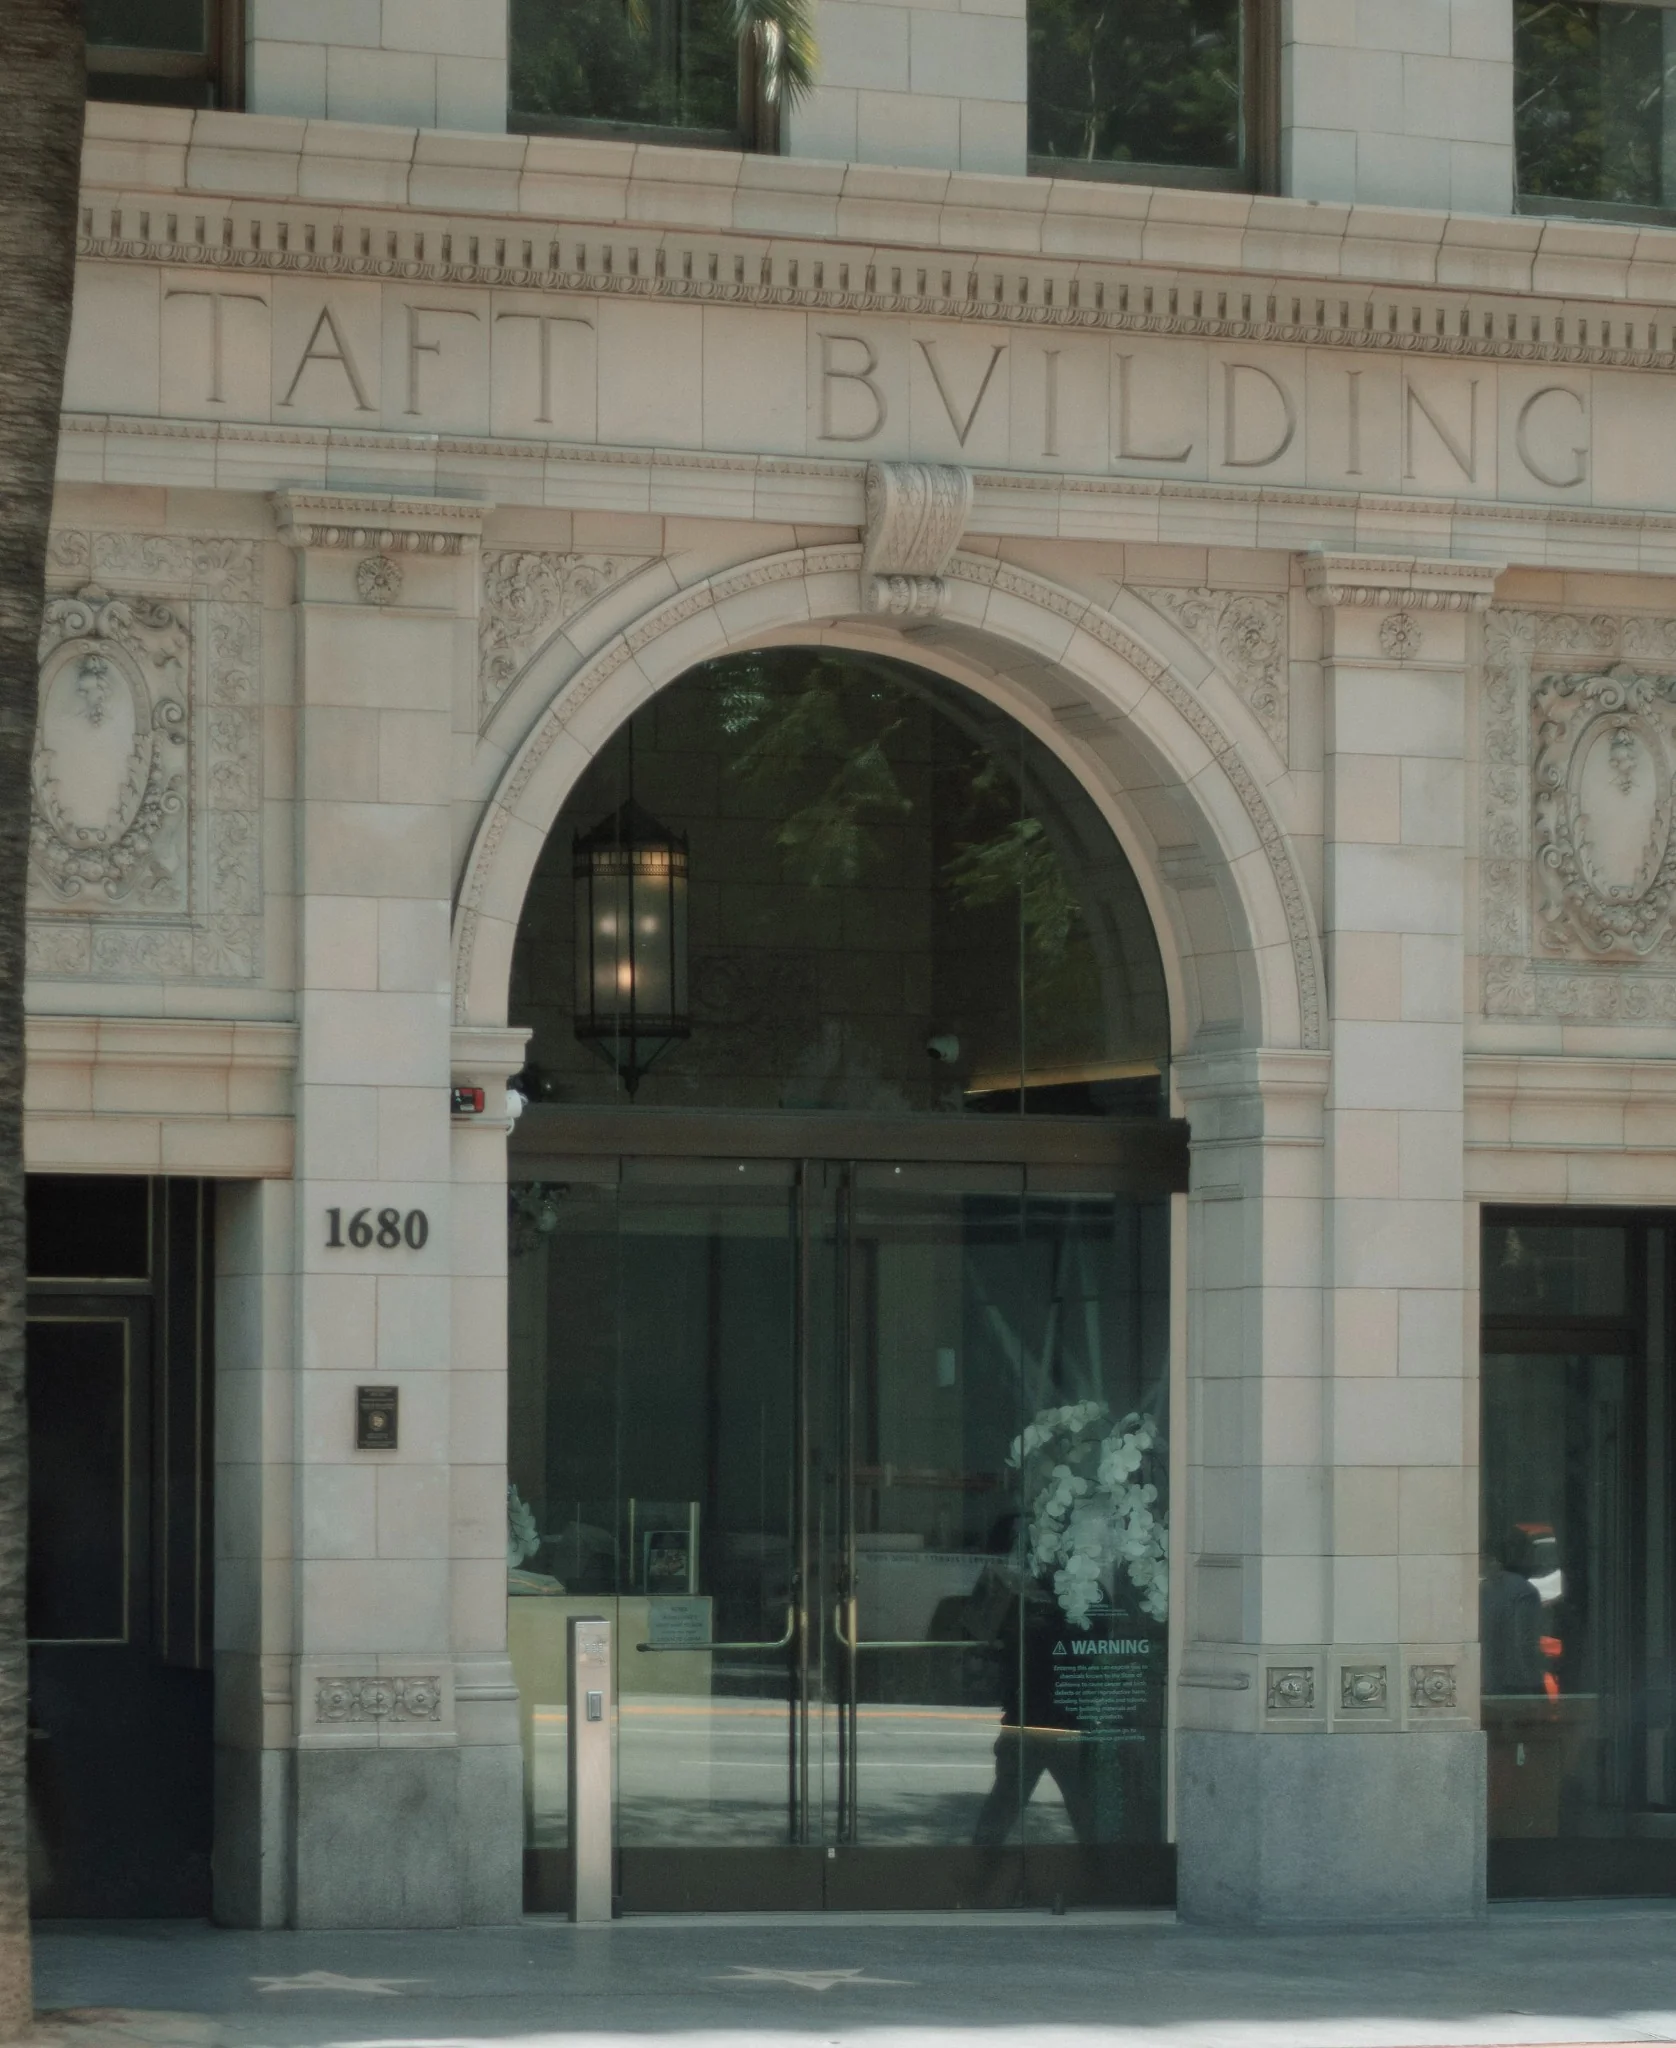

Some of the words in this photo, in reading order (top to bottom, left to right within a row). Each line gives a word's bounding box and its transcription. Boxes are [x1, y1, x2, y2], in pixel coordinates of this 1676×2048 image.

[164, 288, 596, 424] TAFT
[816, 331, 1590, 488] BVILDING
[324, 1207, 430, 1250] 1680
[1071, 1639, 1150, 1655] WARNING
